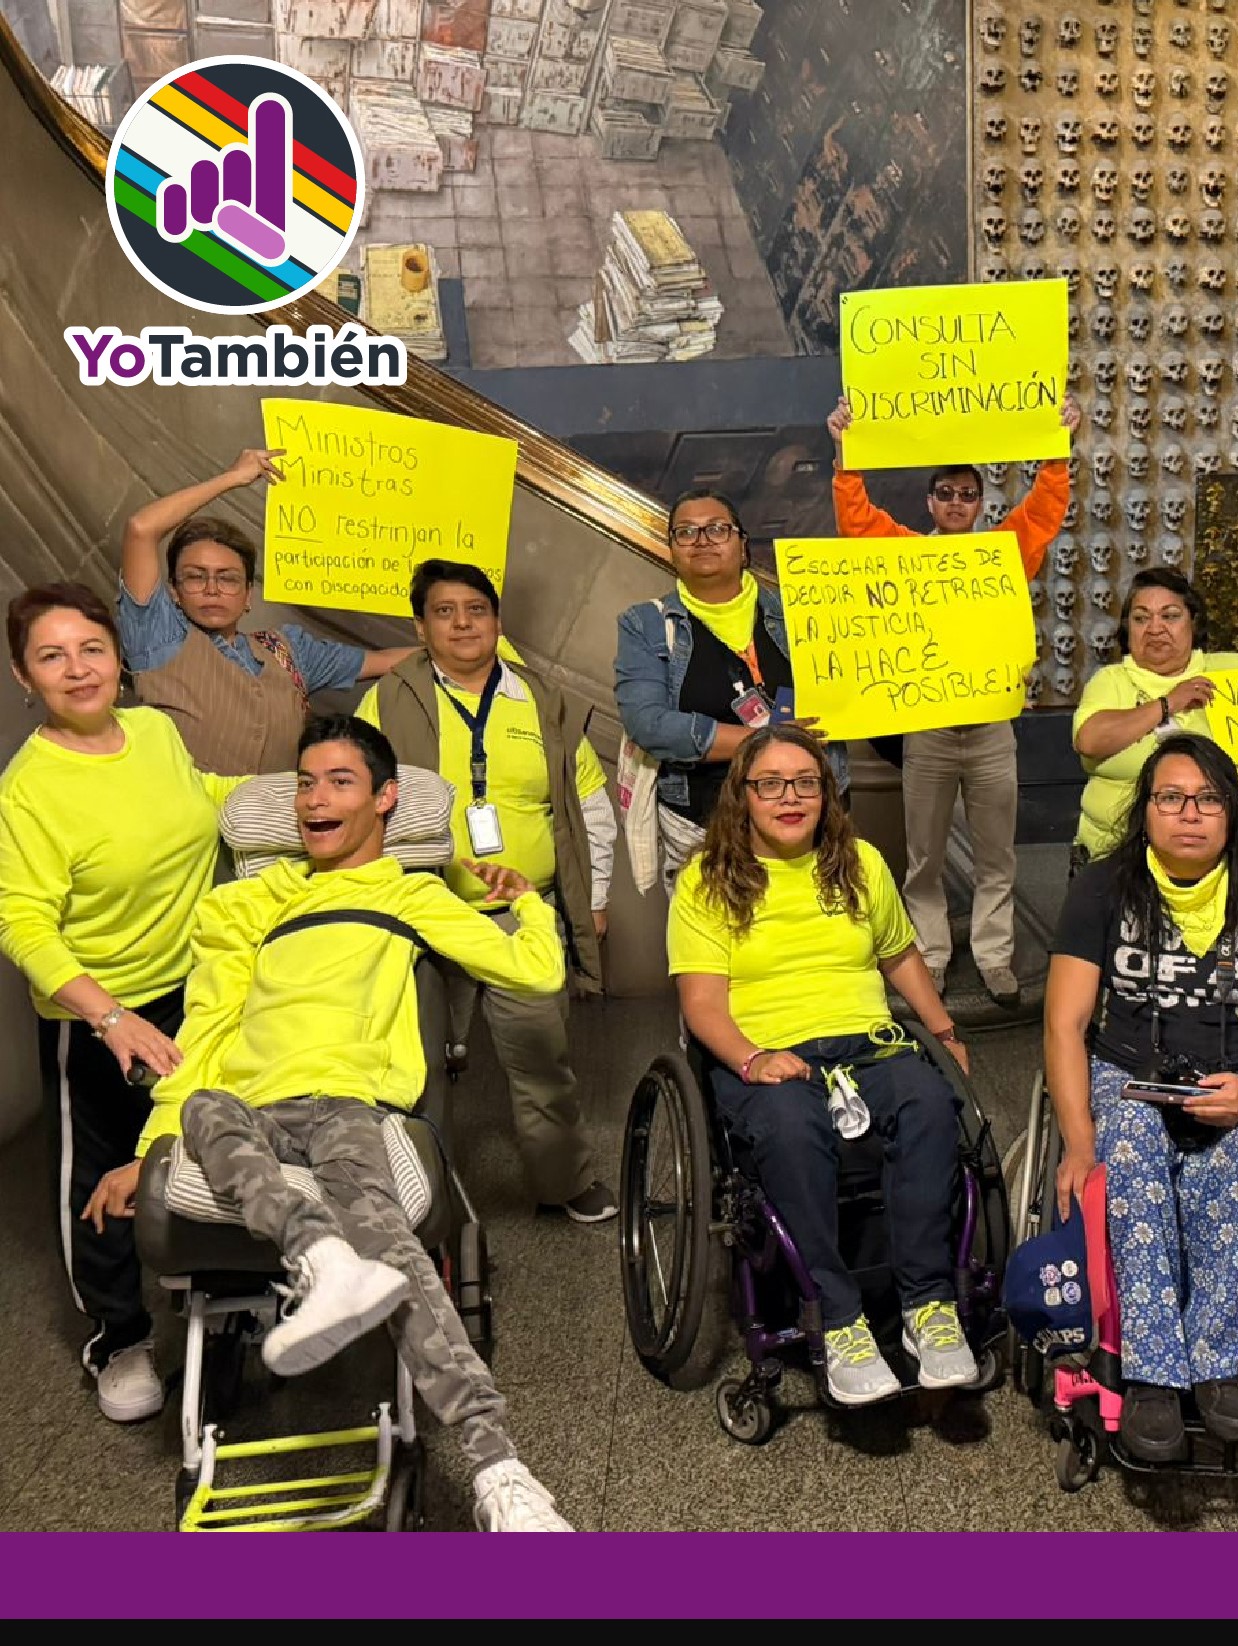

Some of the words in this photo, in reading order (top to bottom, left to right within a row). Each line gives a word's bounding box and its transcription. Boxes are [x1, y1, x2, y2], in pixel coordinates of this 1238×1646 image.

[850, 305, 1016, 354] CONSULTA
[918, 348, 977, 379] SIN
[846, 370, 1057, 421] DISCRIMINACIÓN
[280, 456, 414, 497] Ministras
[279, 504, 317, 533] NO
[336, 513, 442, 558] restrinjan
[457, 520, 475, 549] la
[275, 548, 376, 576] participación
[785, 545, 888, 576] ESCUCHAR
[898, 552, 967, 573] ANTES
[974, 548, 1002, 567] DE
[321, 580, 409, 599] Discapacida
[783, 584, 854, 606] DECIDIR
[866, 581, 898, 609] NO
[905, 574, 1017, 606] RETRASA
[794, 615, 818, 646] LA
[827, 612, 934, 643] JUSTICIA,
[812, 650, 843, 684] LA
[854, 642, 949, 682] HACE
